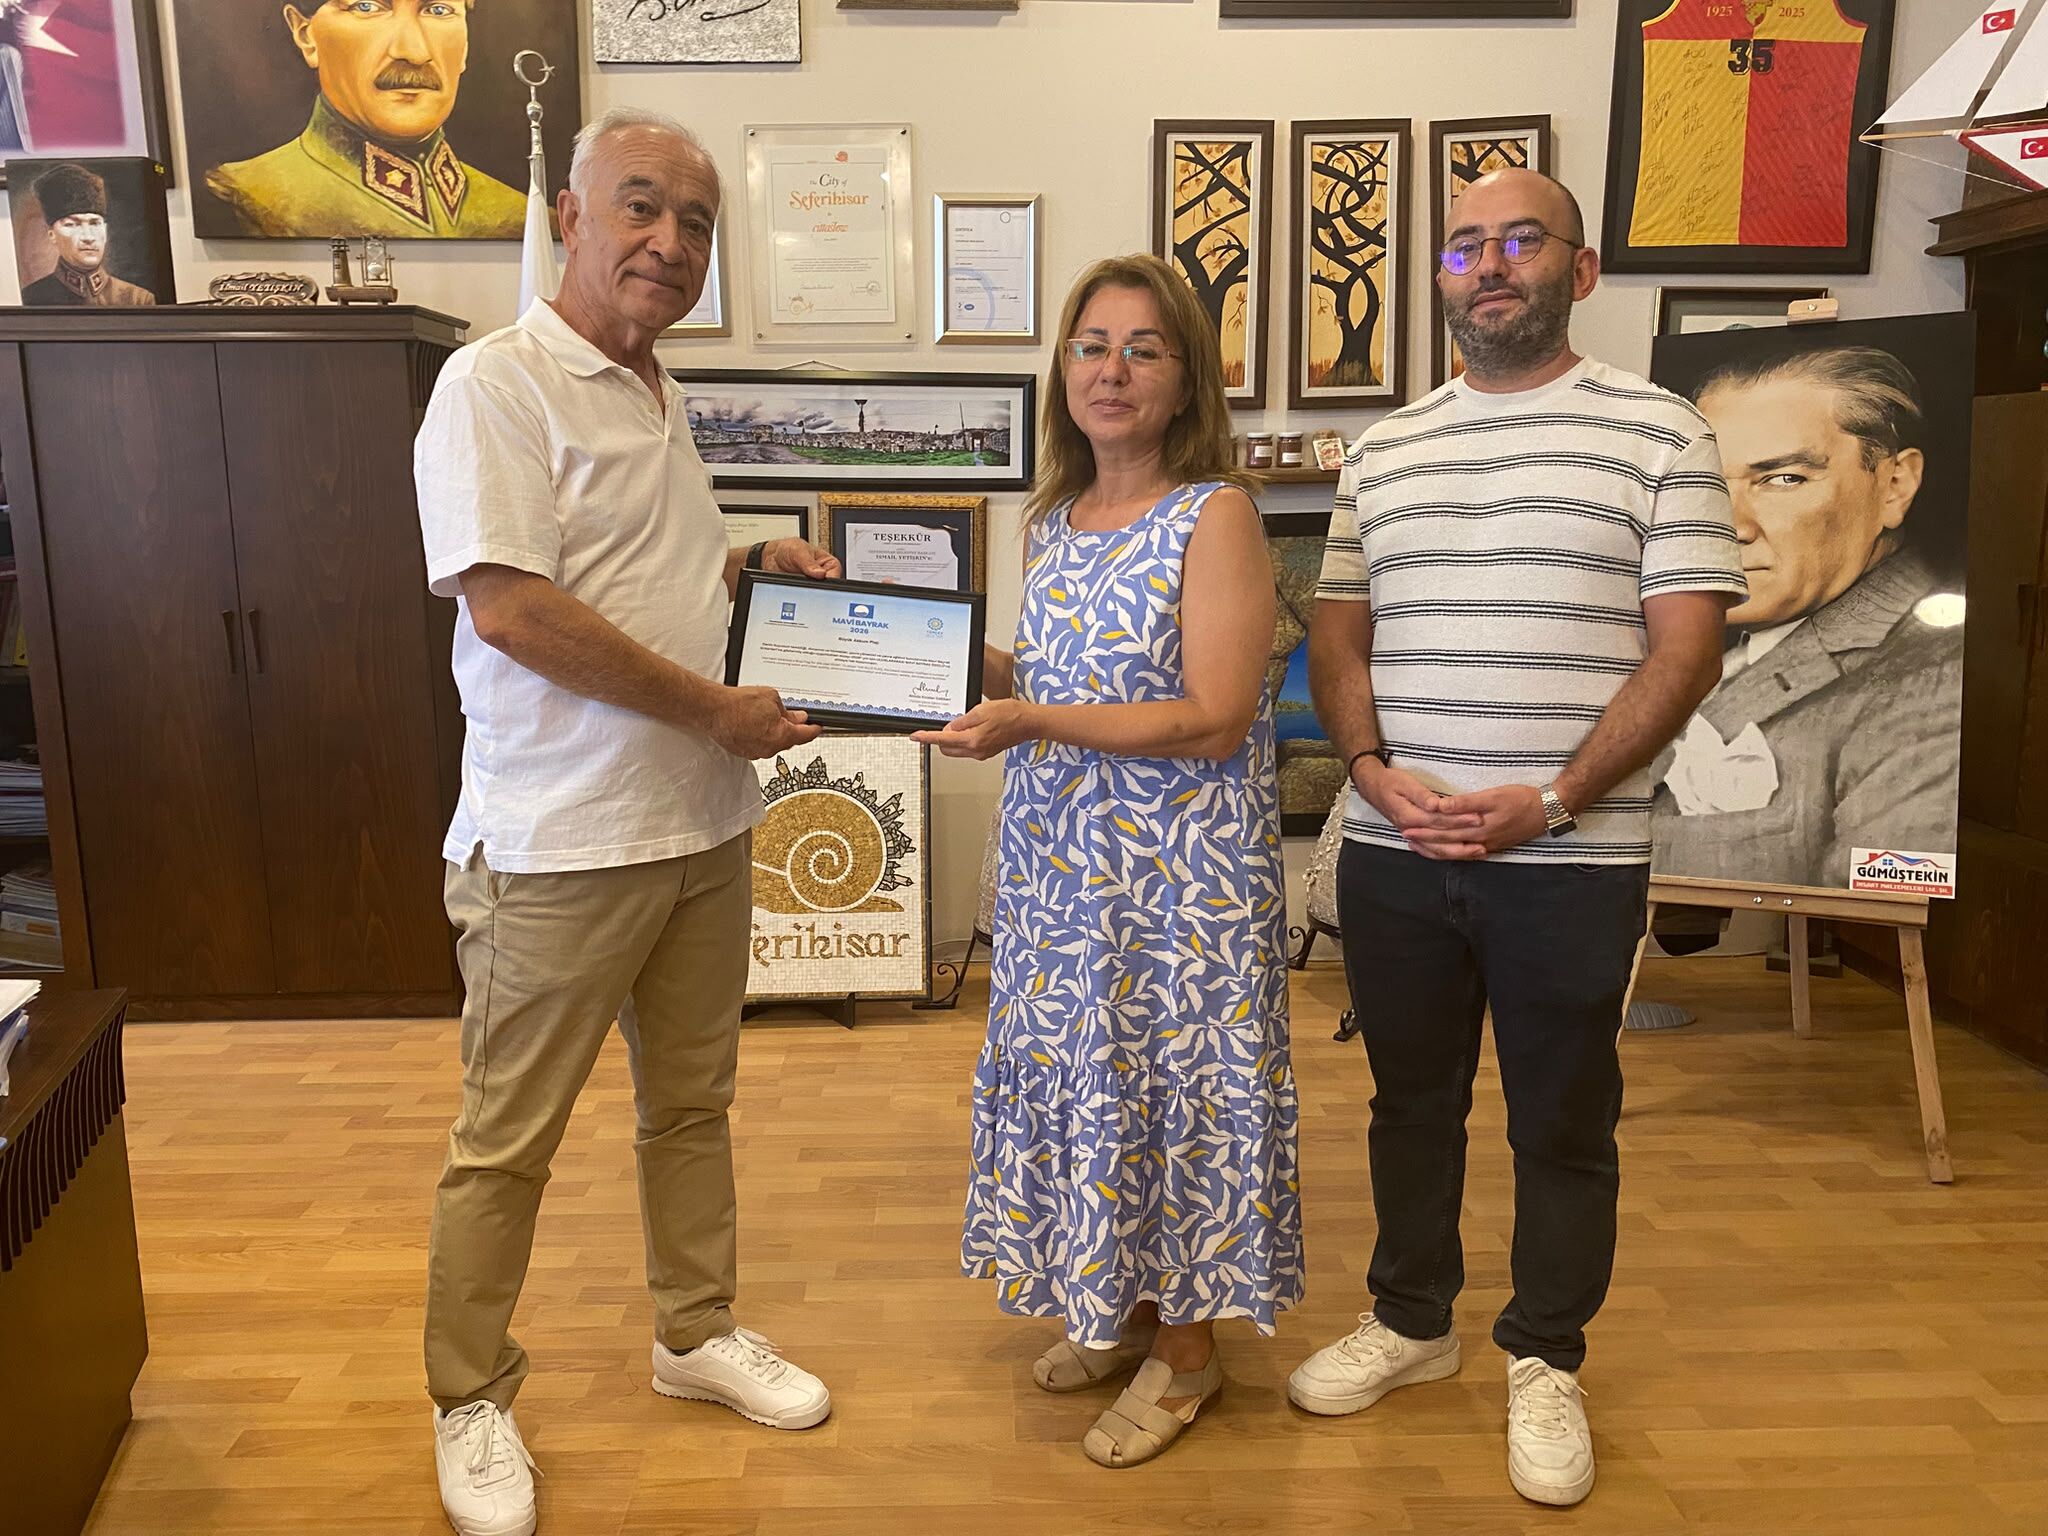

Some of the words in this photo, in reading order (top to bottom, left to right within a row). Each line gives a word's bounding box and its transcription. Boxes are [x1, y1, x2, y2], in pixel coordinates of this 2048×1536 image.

[1706, 6, 1733, 17] 1925
[1778, 7, 1805, 18] 2025
[1727, 38, 1776, 75] 35
[819, 173, 839, 188] City
[789, 190, 870, 211] Seferihisar
[873, 532, 932, 543] TEŞEKKÜR
[855, 619, 889, 630] BAYRAK
[1857, 865, 1948, 883] GÜMÜŞTEKİN
